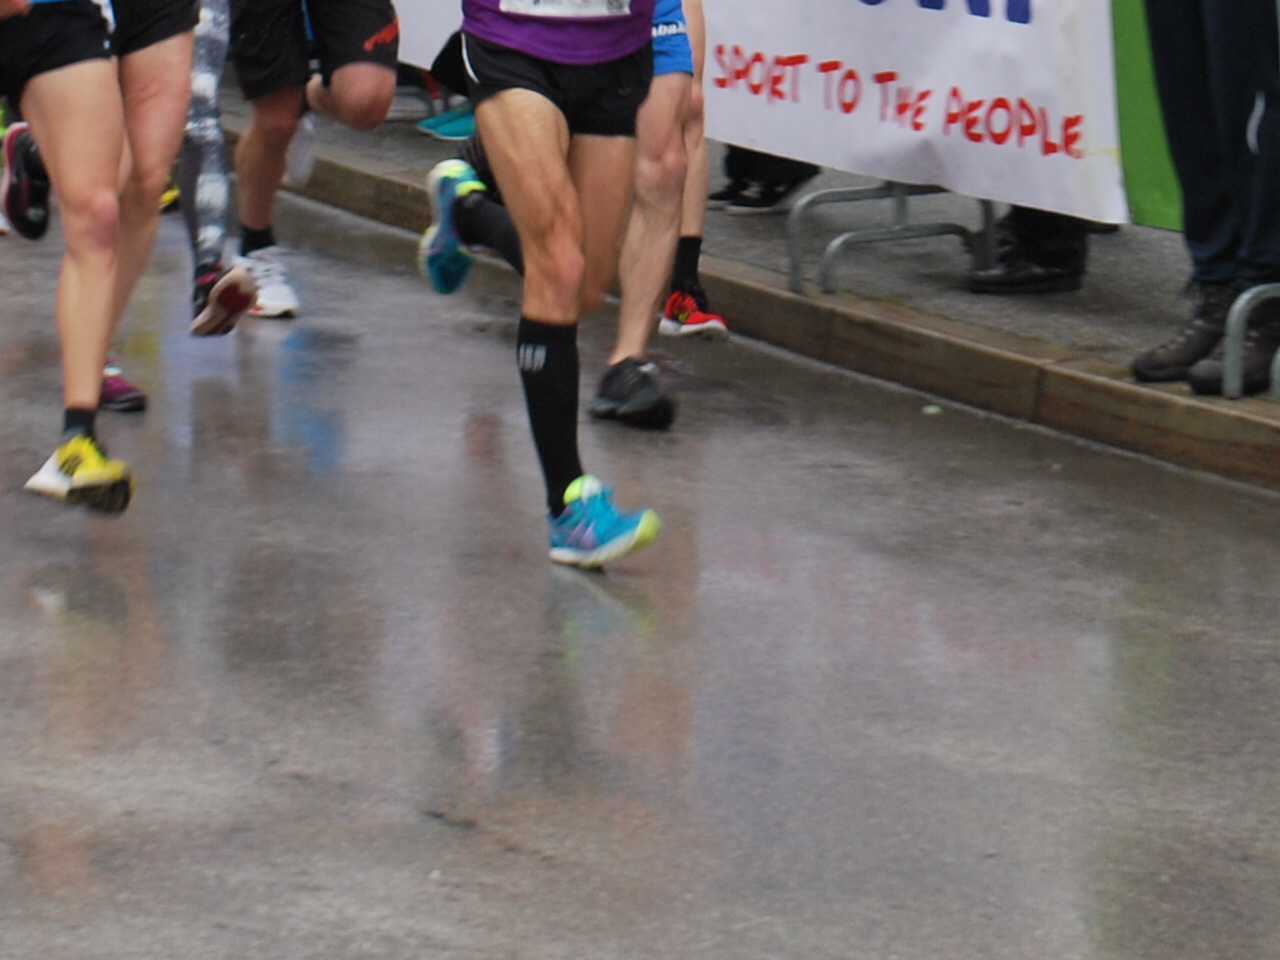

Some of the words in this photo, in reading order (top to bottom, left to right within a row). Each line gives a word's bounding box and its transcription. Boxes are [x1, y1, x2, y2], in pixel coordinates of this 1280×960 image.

[714, 43, 809, 104] SPORT
[816, 60, 864, 115] TO
[873, 71, 933, 132] THE
[942, 86, 1086, 159] PEOPLE
